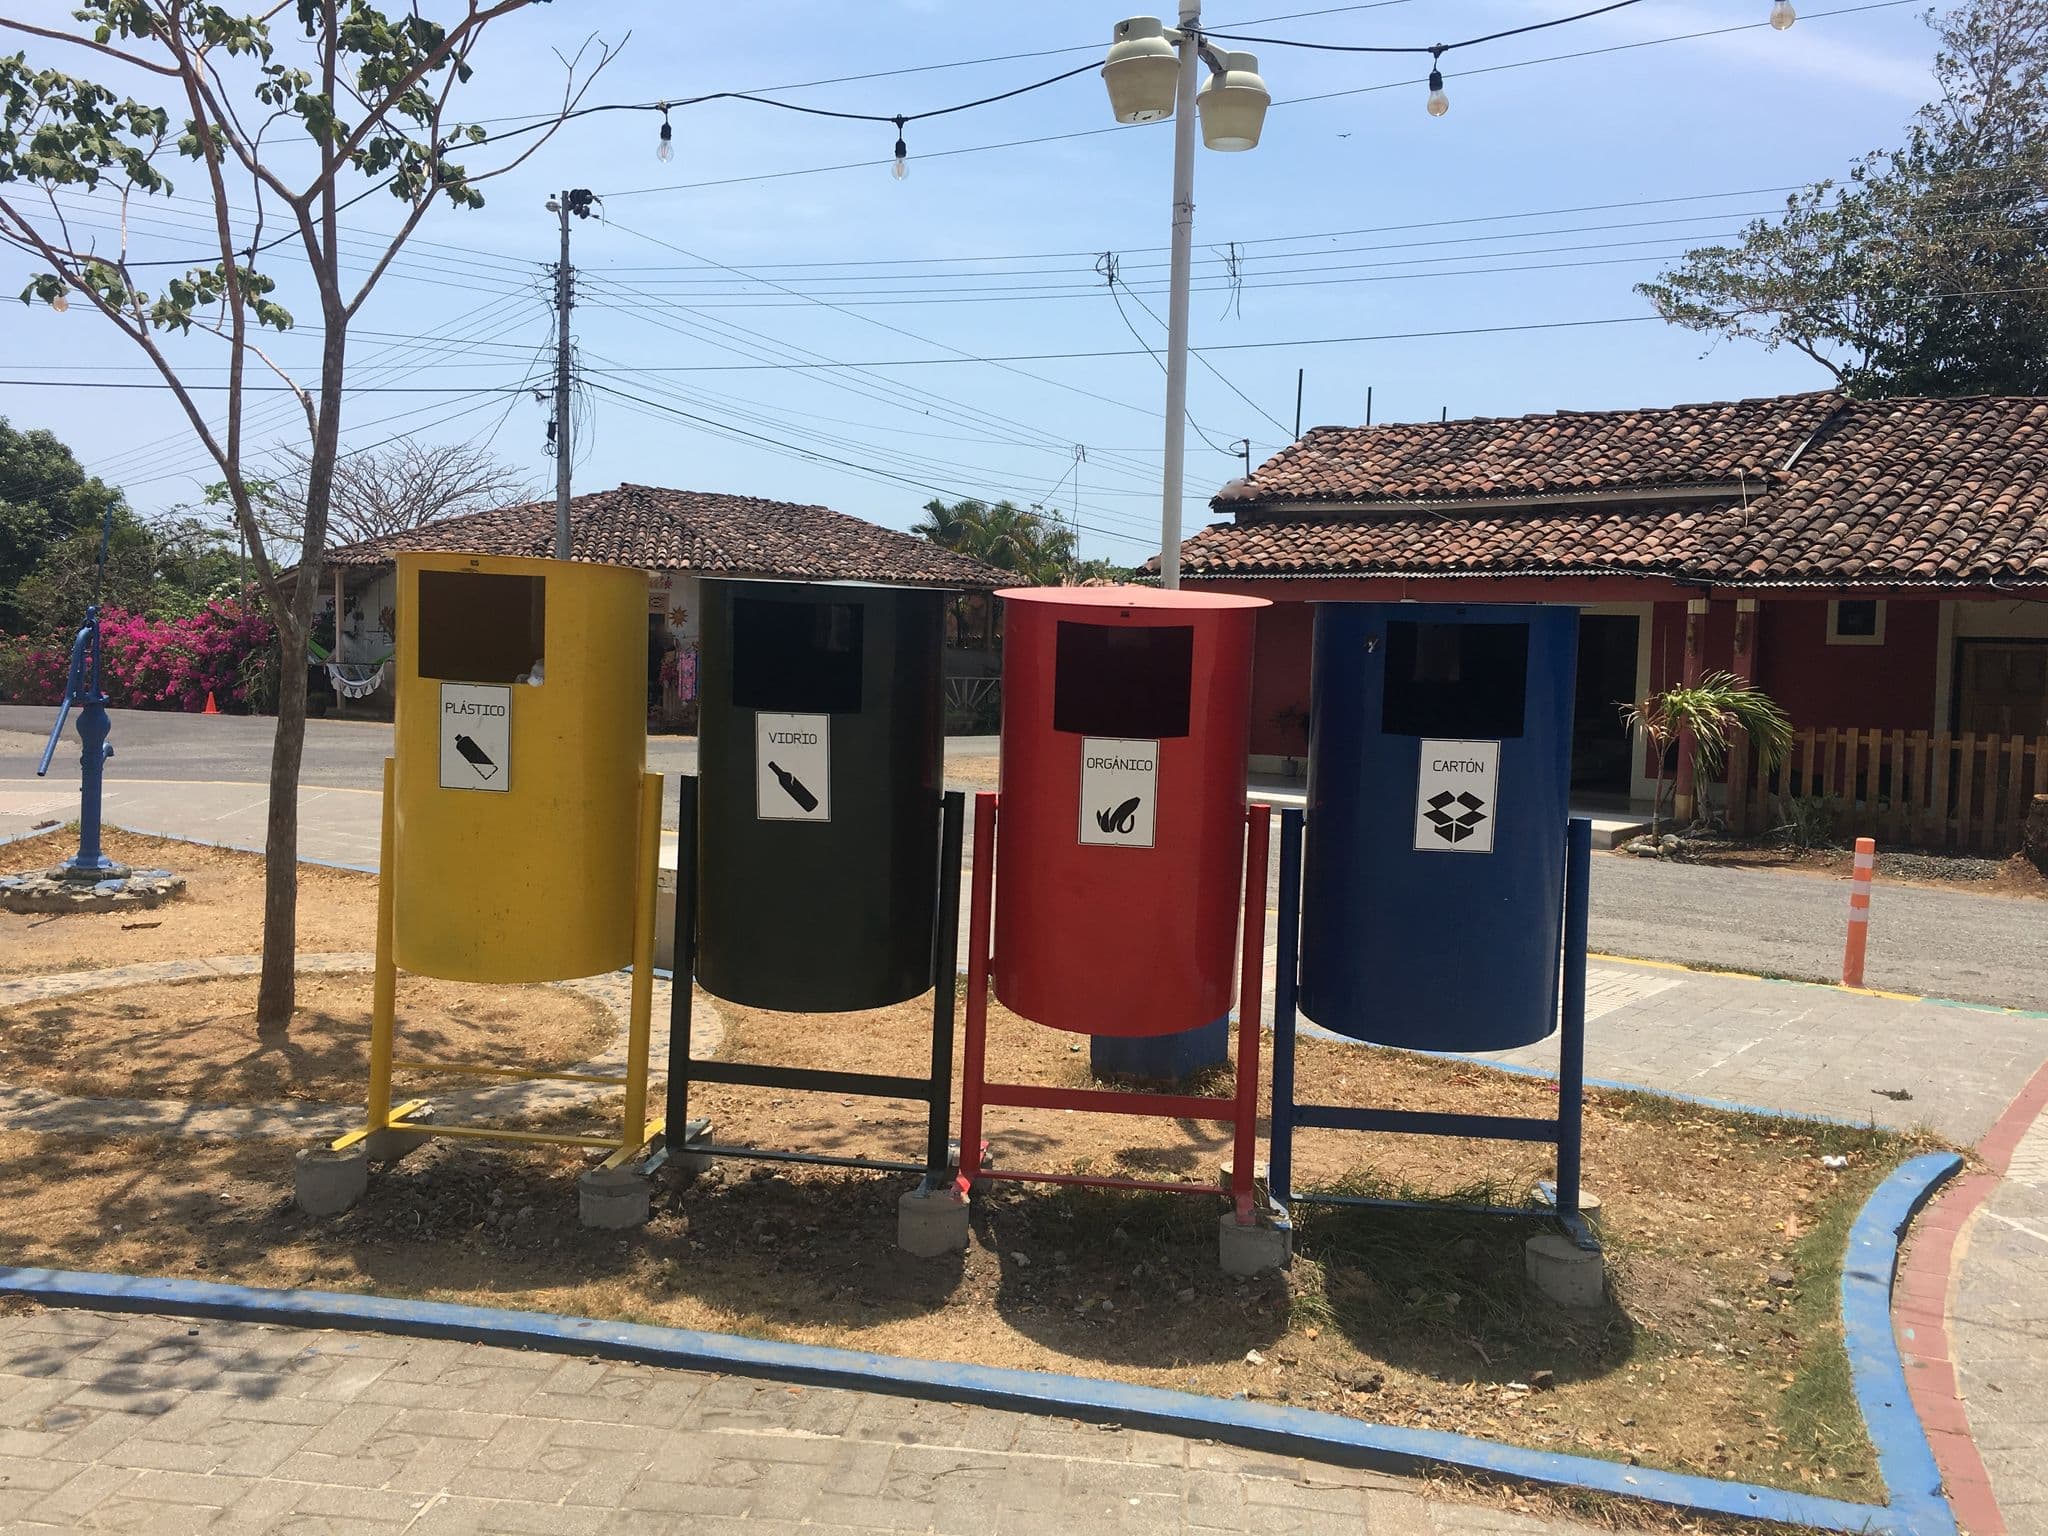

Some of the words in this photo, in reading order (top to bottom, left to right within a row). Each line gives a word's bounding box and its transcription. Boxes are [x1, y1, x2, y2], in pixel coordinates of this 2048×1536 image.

[445, 700, 506, 717] PLÁSTICO
[768, 732, 818, 745] VIDRIO
[1086, 755, 1153, 772] ORGÁNICO
[1432, 758, 1485, 773] CARTÓN
